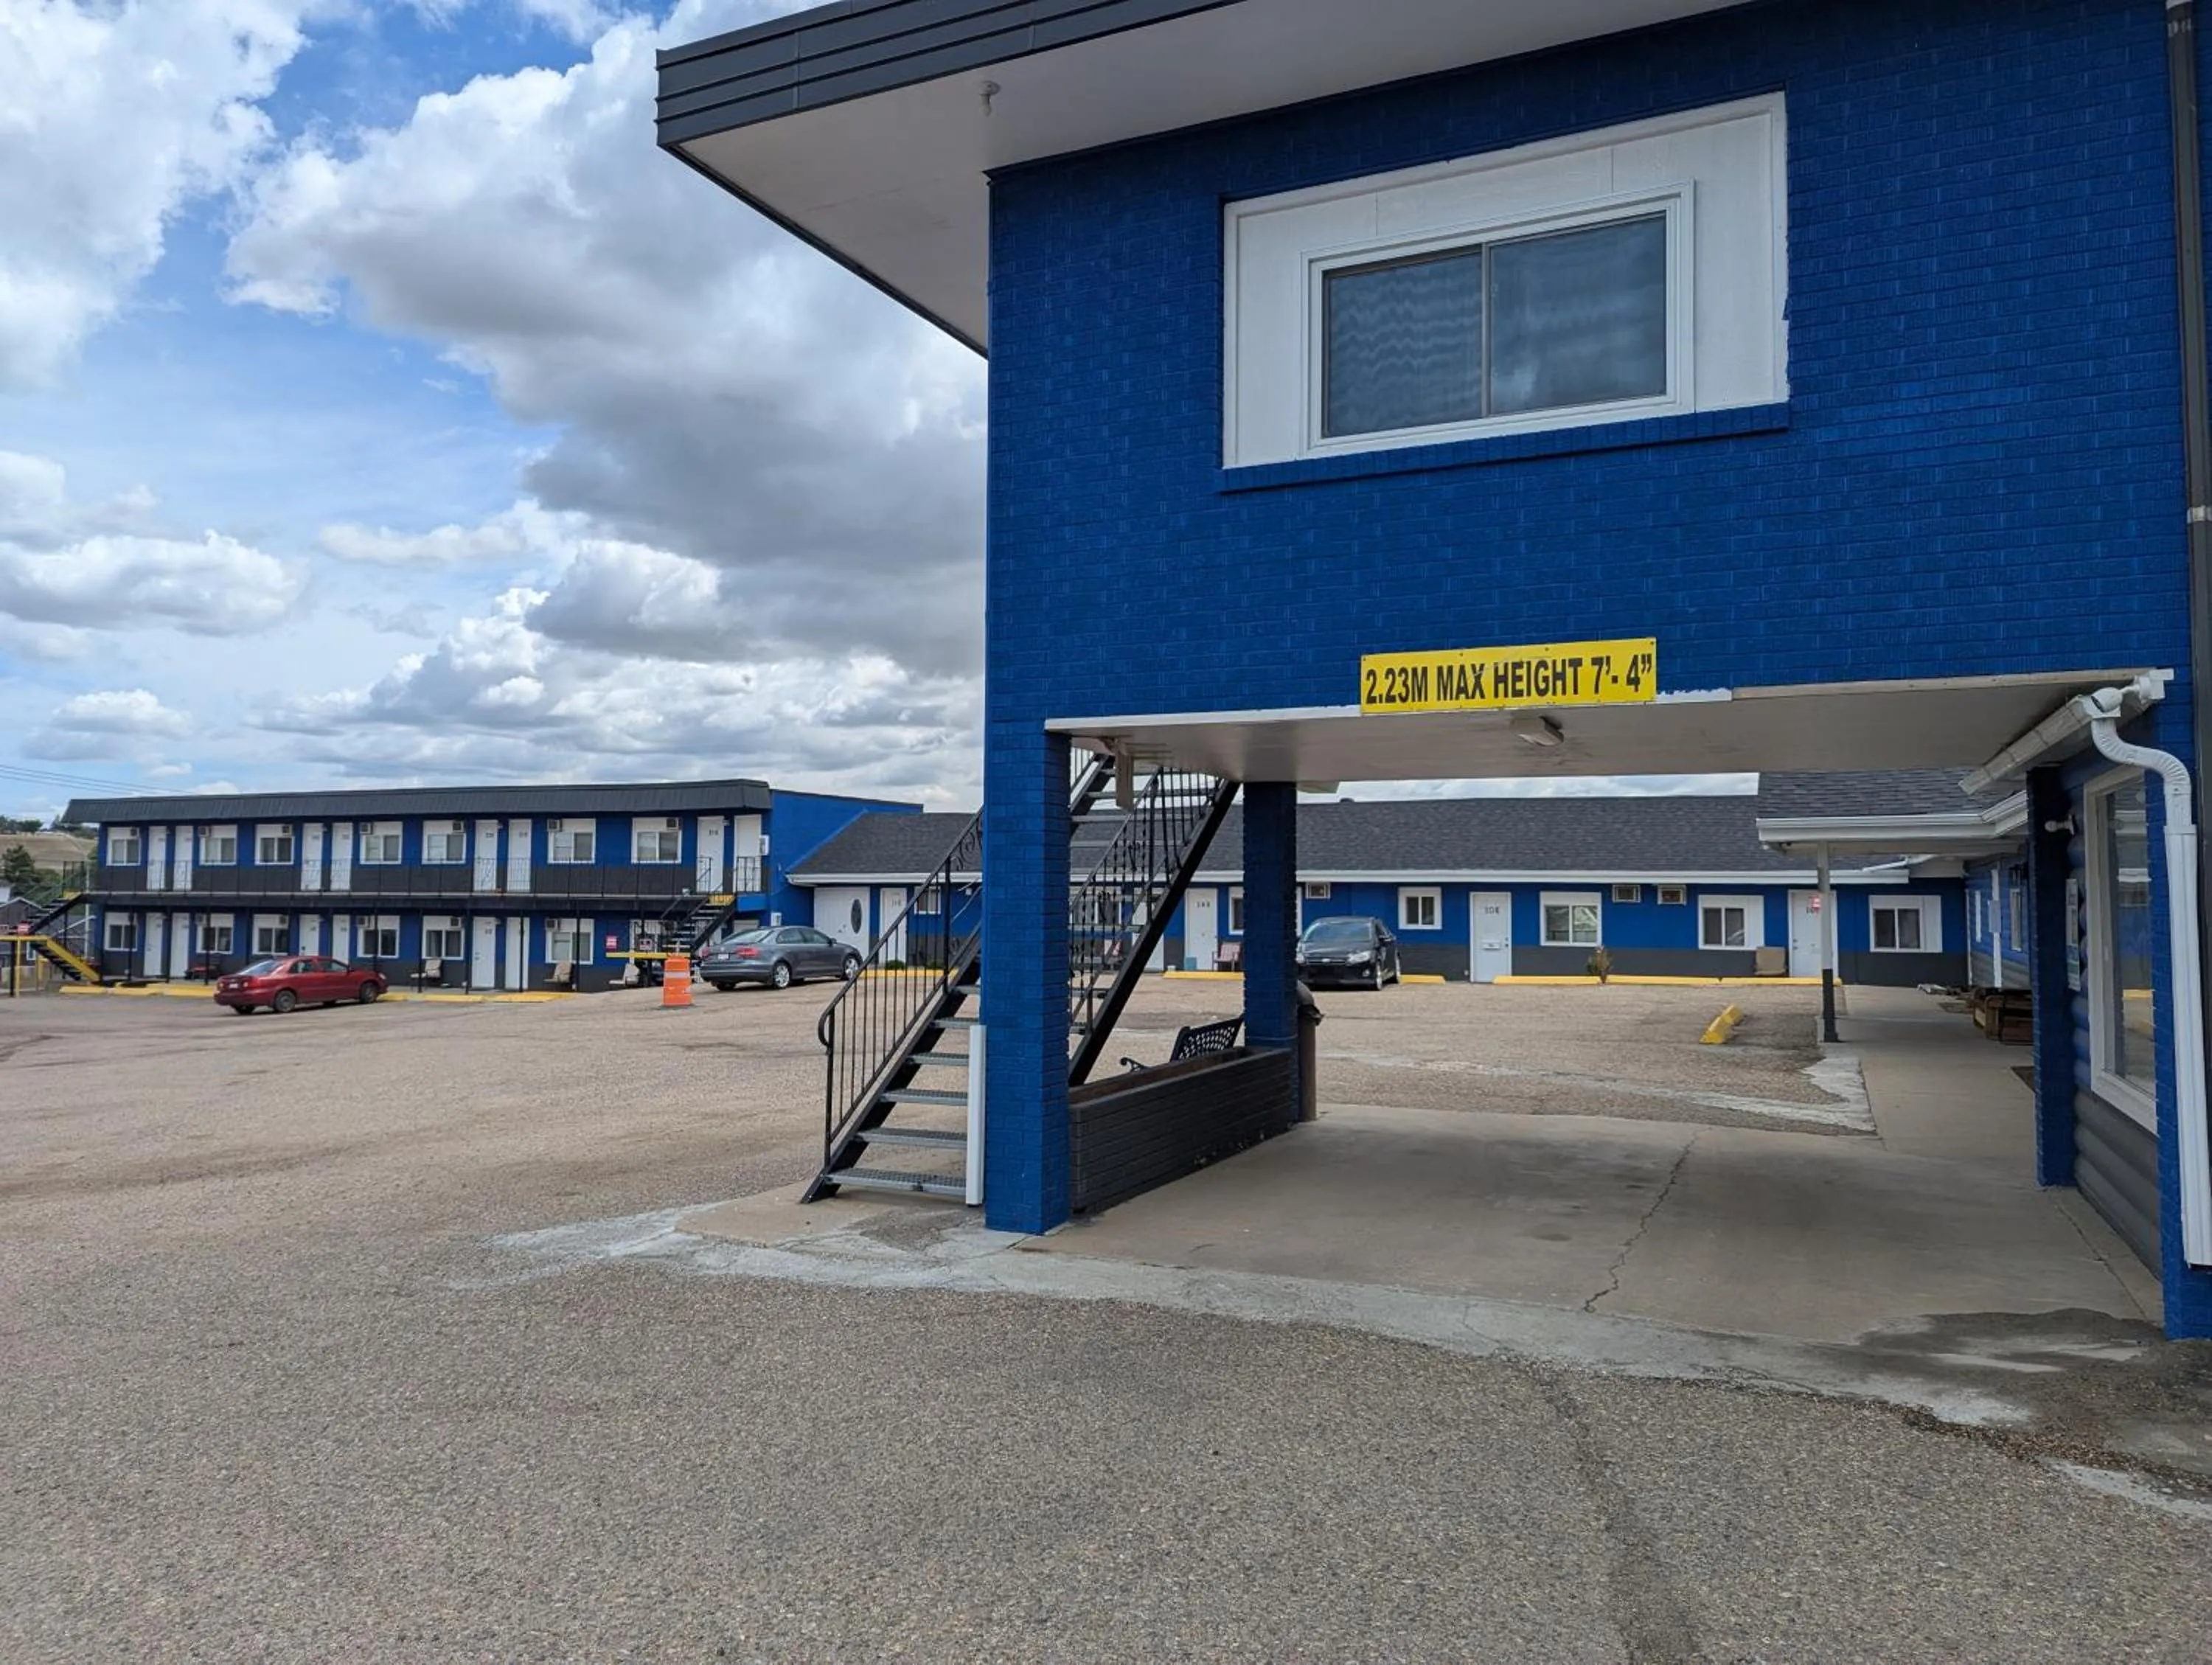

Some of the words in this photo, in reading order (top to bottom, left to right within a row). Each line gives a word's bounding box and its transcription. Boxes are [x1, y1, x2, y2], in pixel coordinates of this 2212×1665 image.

[1366, 666, 1428, 704] 2.23M
[1436, 663, 1486, 701] MAX
[1494, 657, 1583, 699] HEIGHT
